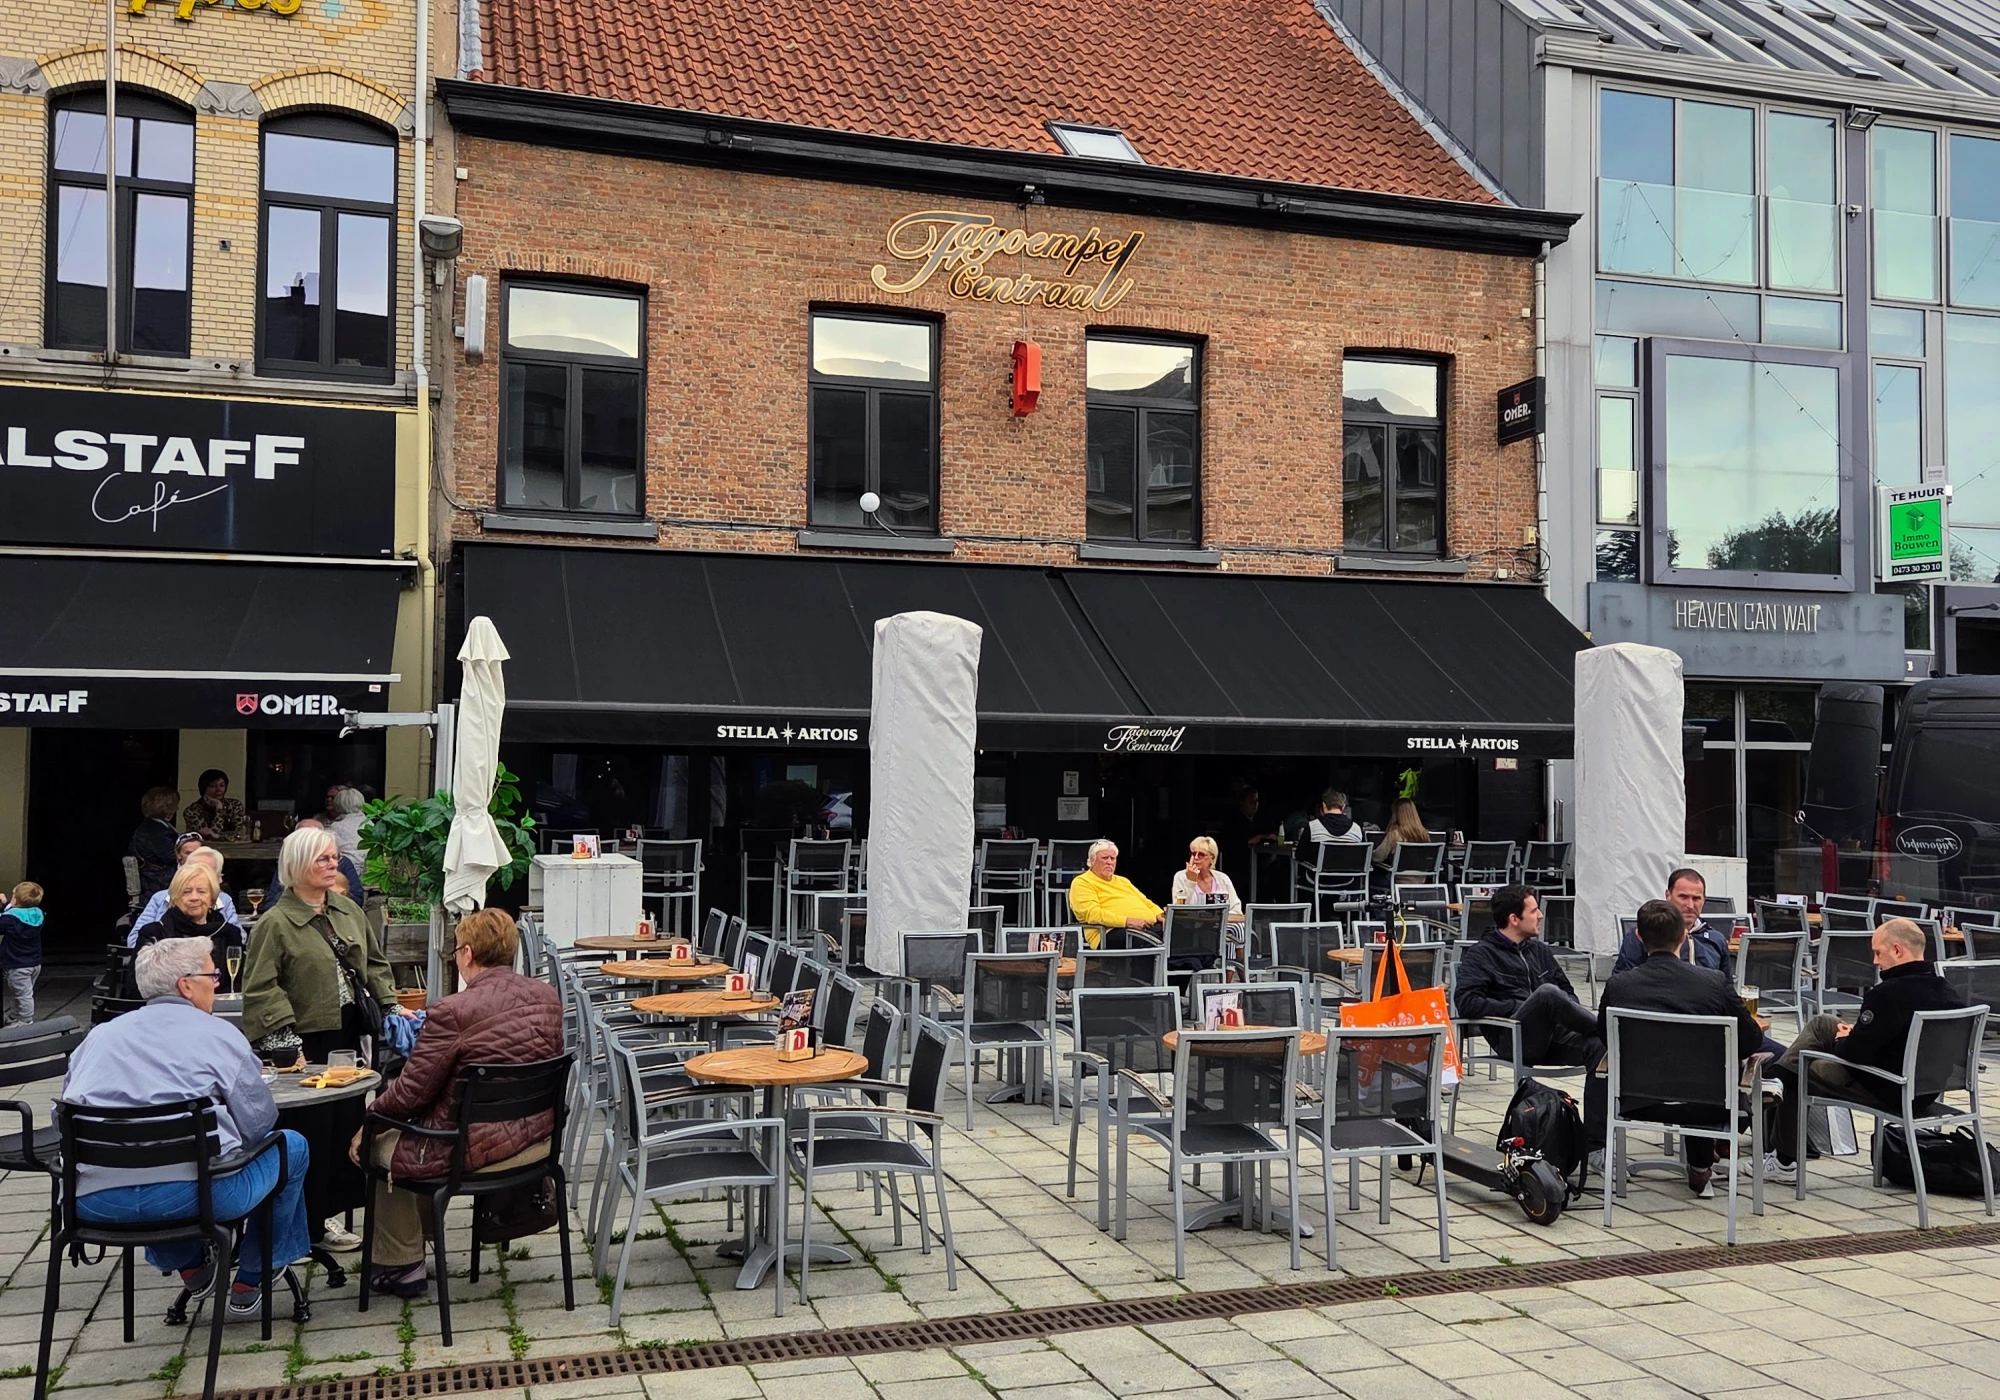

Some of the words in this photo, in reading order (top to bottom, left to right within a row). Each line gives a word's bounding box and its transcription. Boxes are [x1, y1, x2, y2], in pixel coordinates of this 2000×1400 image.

[949, 259, 1135, 312] Centraal
[0, 427, 305, 479] LSTAFF
[1891, 493, 1906, 501] TE
[1909, 488, 1944, 499] HUUR
[1902, 534, 1929, 542] Immo
[1894, 540, 1938, 550] Bouwen
[1911, 564, 1921, 572] 30
[1921, 564, 1931, 572] 20
[1931, 562, 1941, 570] 10
[1676, 600, 1738, 630] HEAVEN
[1744, 603, 1777, 630] CAN
[1783, 604, 1821, 632] WAIT
[716, 725, 779, 739] STELLA
[797, 728, 859, 741] ARTOIS
[1126, 740, 1184, 752] Centraal
[1407, 738, 1456, 749] STELLA
[1471, 739, 1520, 750] ARTOIS
